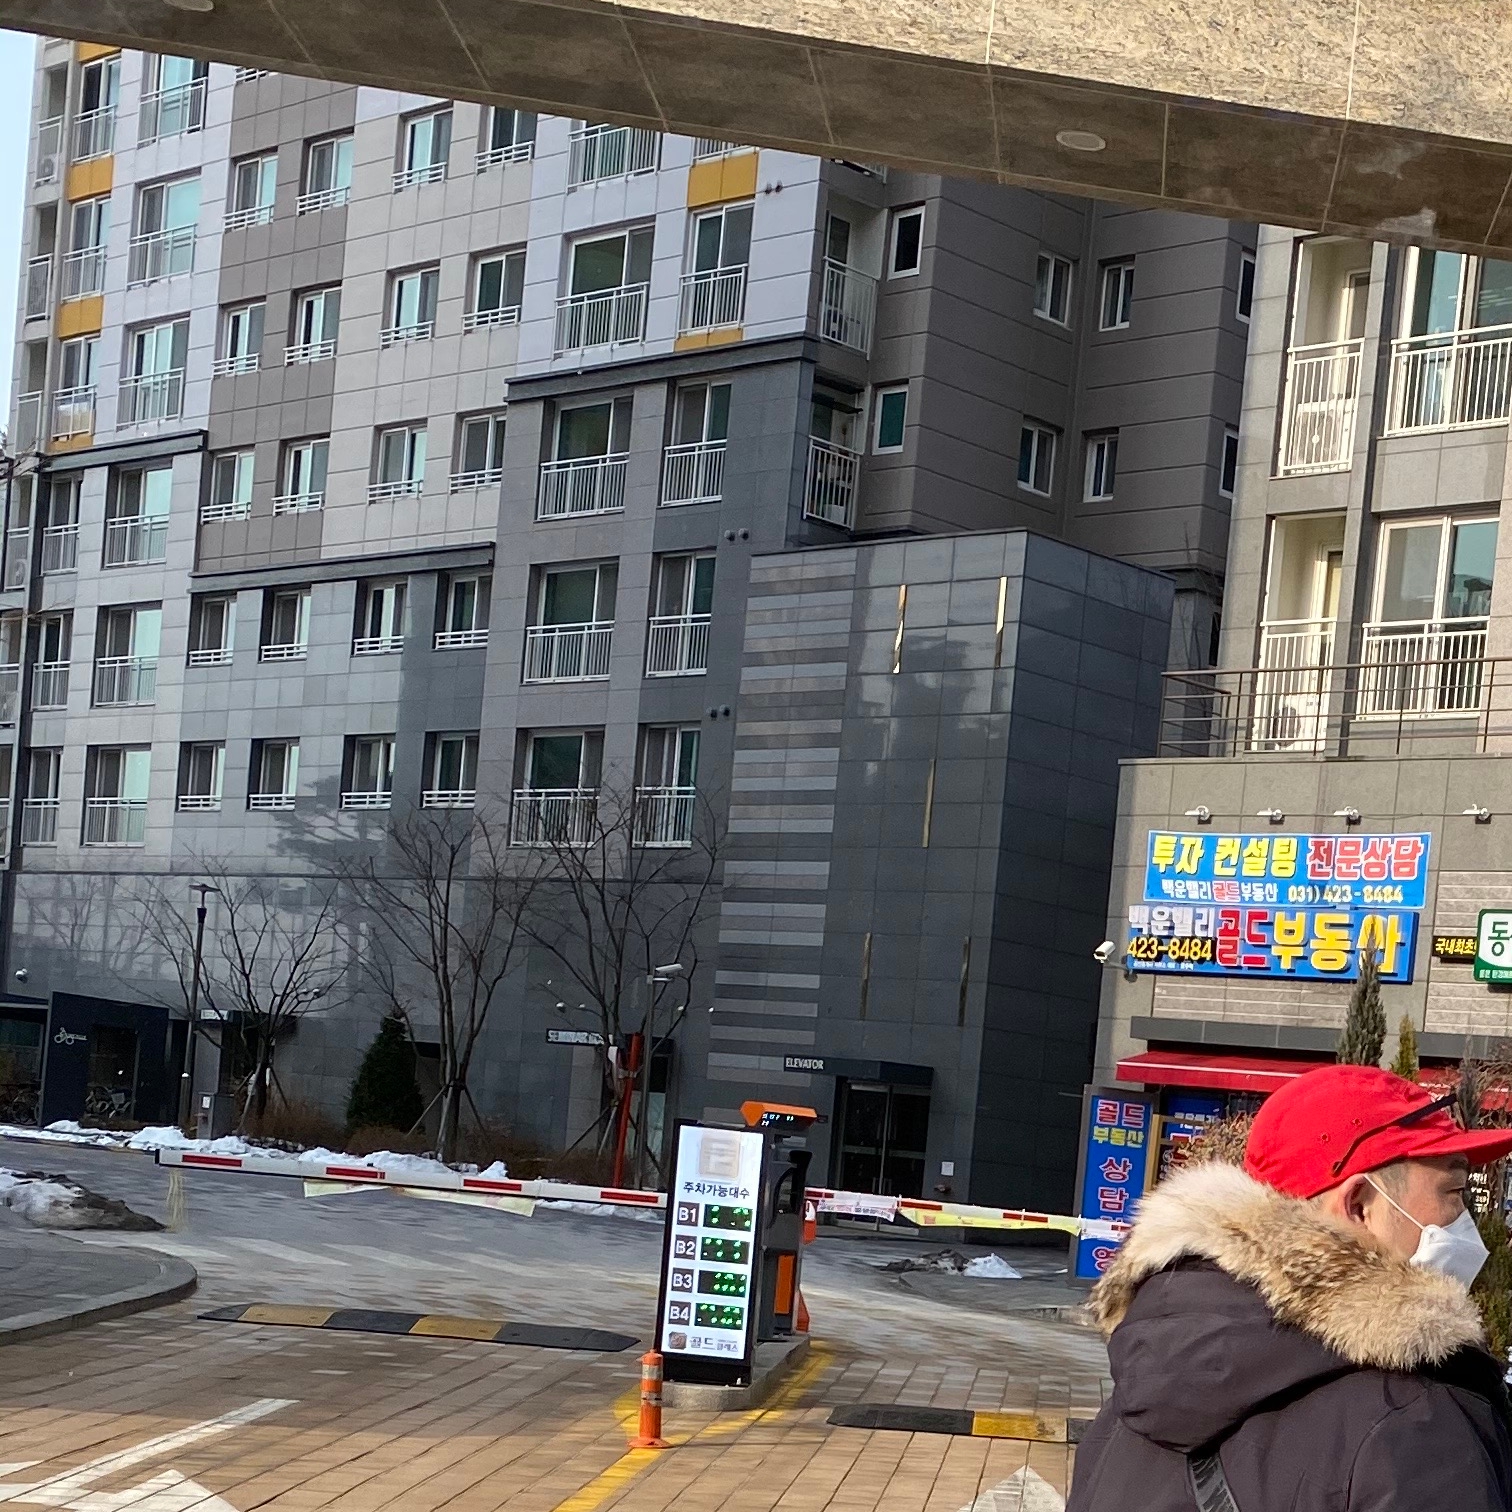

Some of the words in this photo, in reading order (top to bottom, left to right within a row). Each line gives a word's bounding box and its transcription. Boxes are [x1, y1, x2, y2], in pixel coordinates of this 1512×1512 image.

[1152, 835, 1205, 875] 투자
[1213, 837, 1298, 878] 컨설팅
[1307, 837, 1424, 880] 전문상담
[1129, 905, 1215, 937] 백운밸리
[1127, 937, 1212, 960] 423-8484
[786, 1057, 824, 1070] ELEVATOR
[1097, 1100, 1145, 1129] 골드
[1093, 1126, 1144, 1148] 부동산
[683, 1181, 750, 1200] 주차가능대수
[678, 1207, 697, 1223] B1
[675, 1240, 695, 1256] B2
[672, 1273, 692, 1289] B3
[669, 1306, 689, 1321] B4
